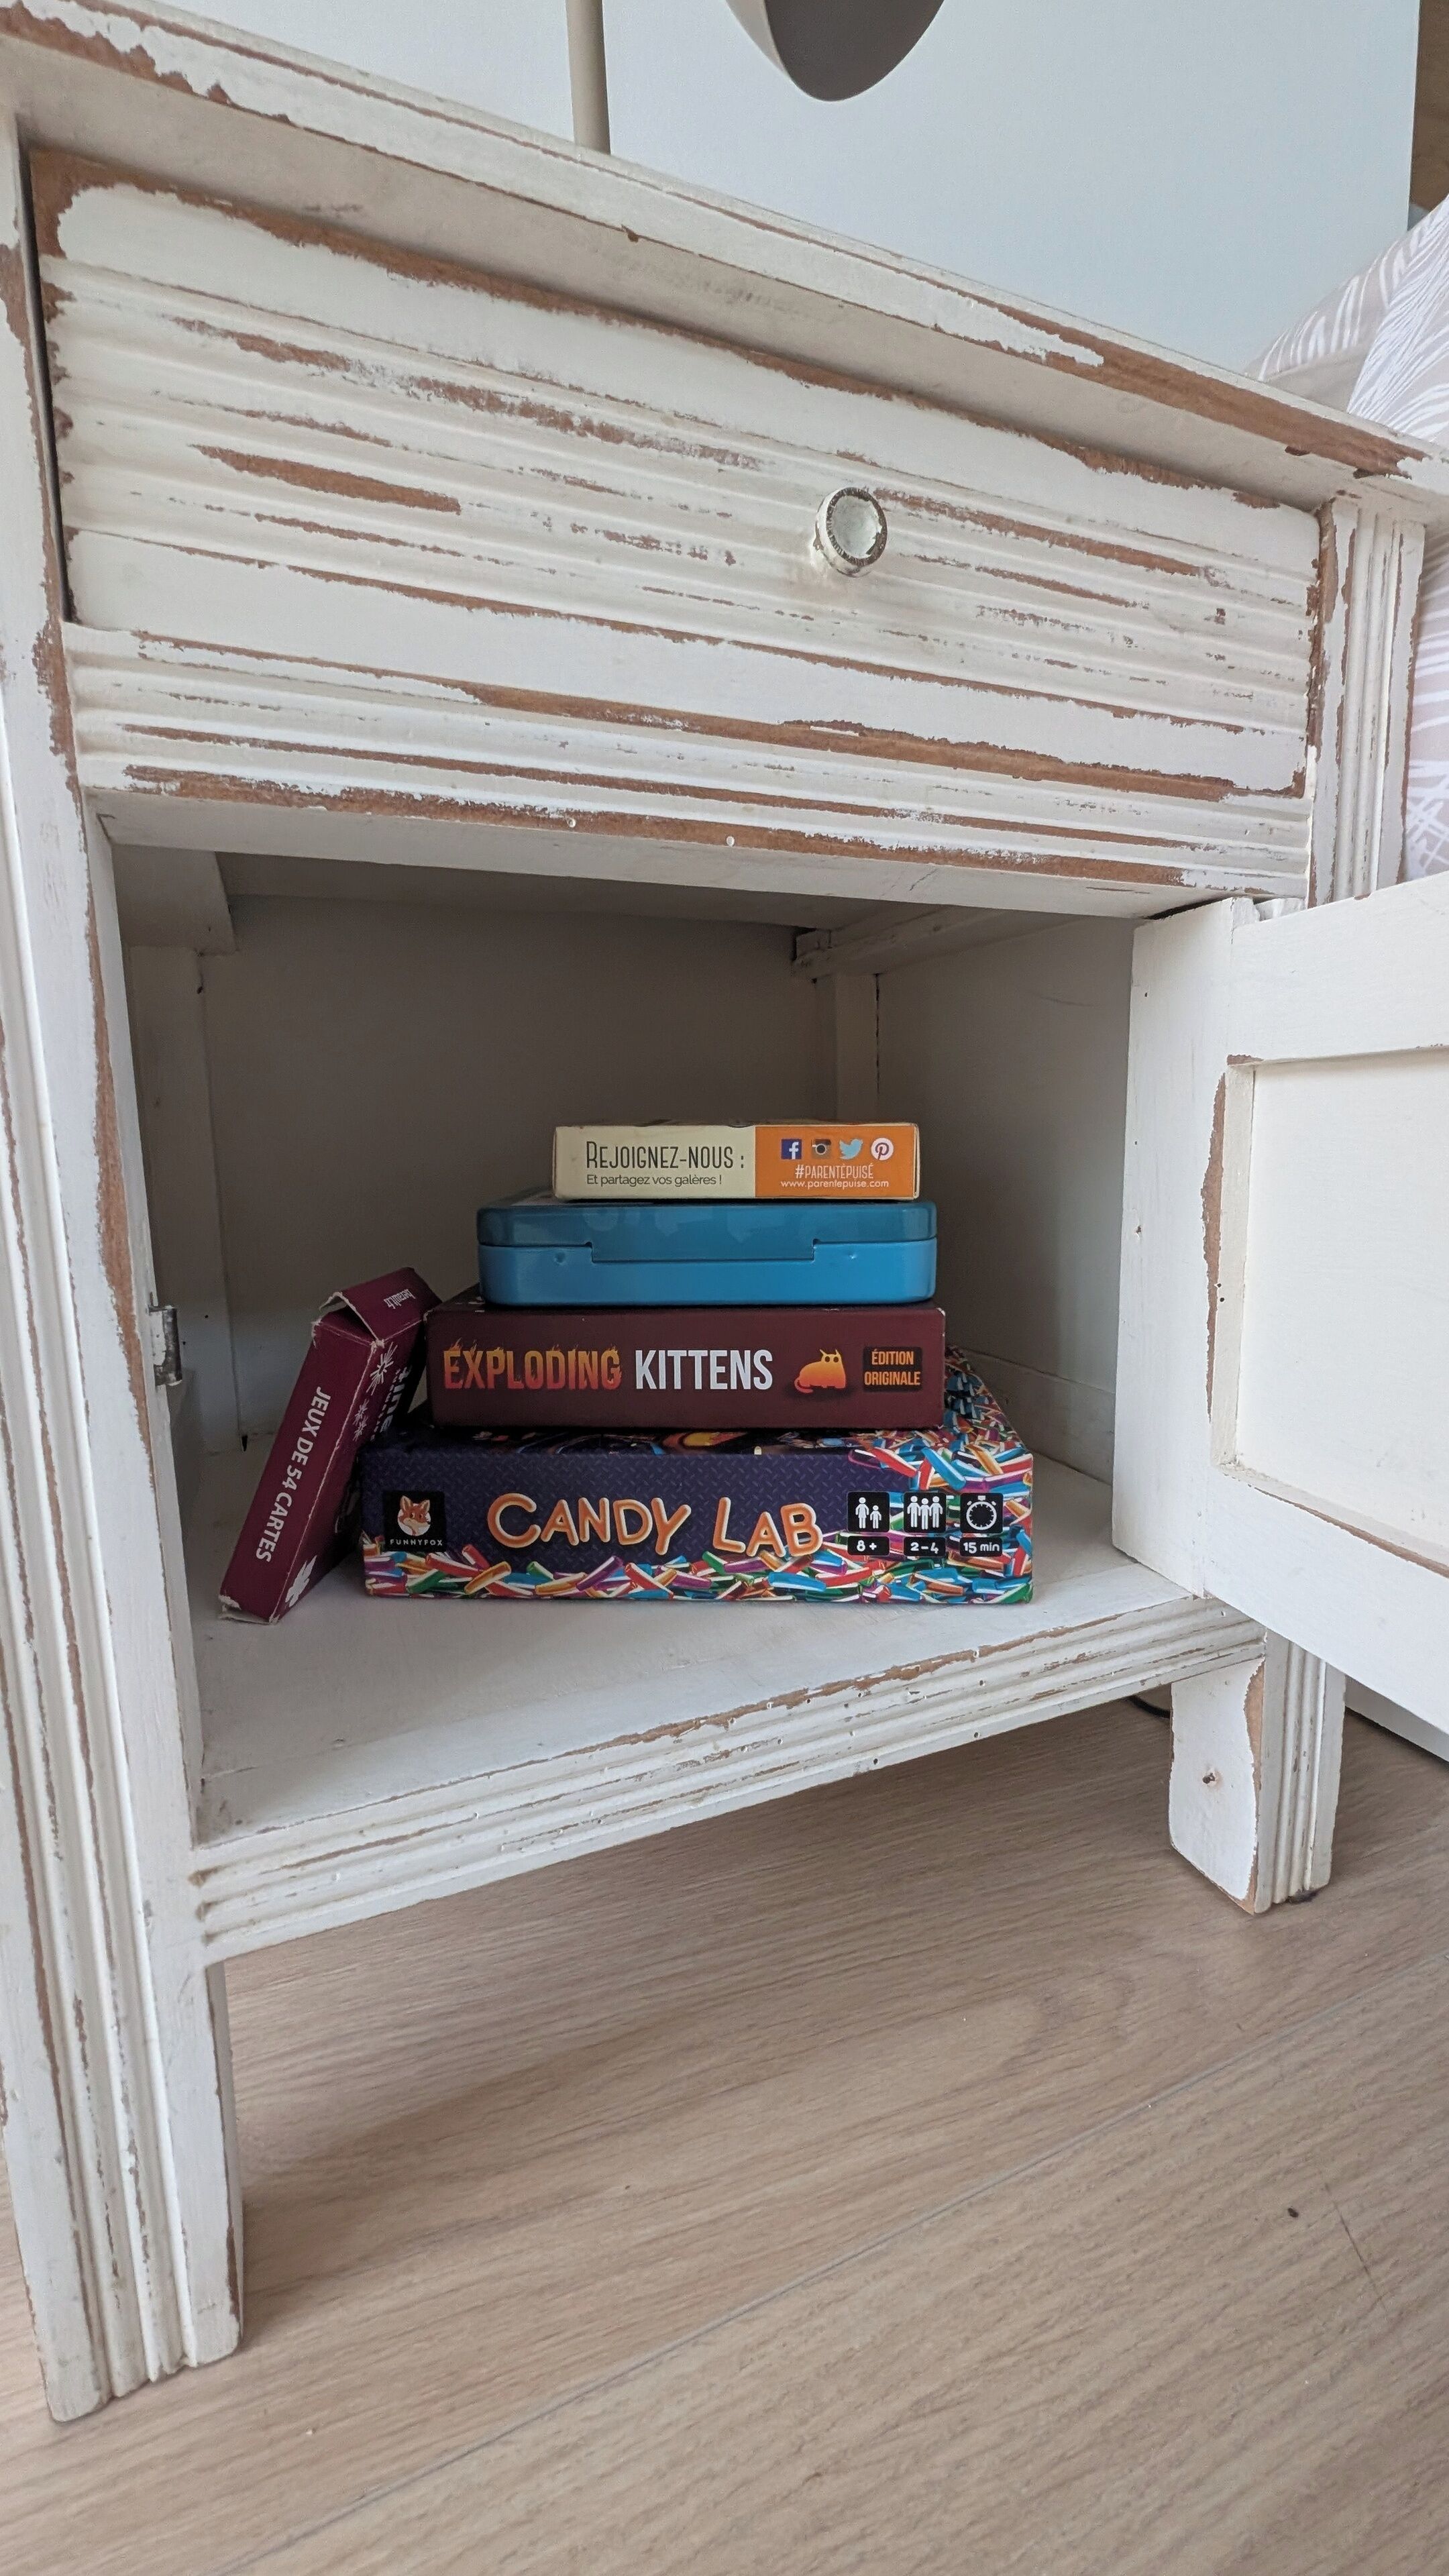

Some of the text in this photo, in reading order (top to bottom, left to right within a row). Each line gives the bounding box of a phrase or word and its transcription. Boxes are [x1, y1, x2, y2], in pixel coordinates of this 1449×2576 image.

[586, 1141, 733, 1169] REJOIGNEZ-NOUS
[586, 1175, 598, 1185] Et
[600, 1175, 650, 1187] partagez
[652, 1177, 672, 1185] vos
[674, 1174, 716, 1187] galères
[780, 1179, 890, 1190] www.parentepuise.com
[871, 1348, 914, 1365] ÉDITION
[443, 1343, 773, 1390] EXPLODING KITTENS
[863, 1371, 922, 1386] ORIGINALE
[256, 1386, 331, 1563] JEUX DE 54 CARTES
[486, 1492, 824, 1557] CANDY LAB
[963, 1542, 1000, 1554] 15 min
